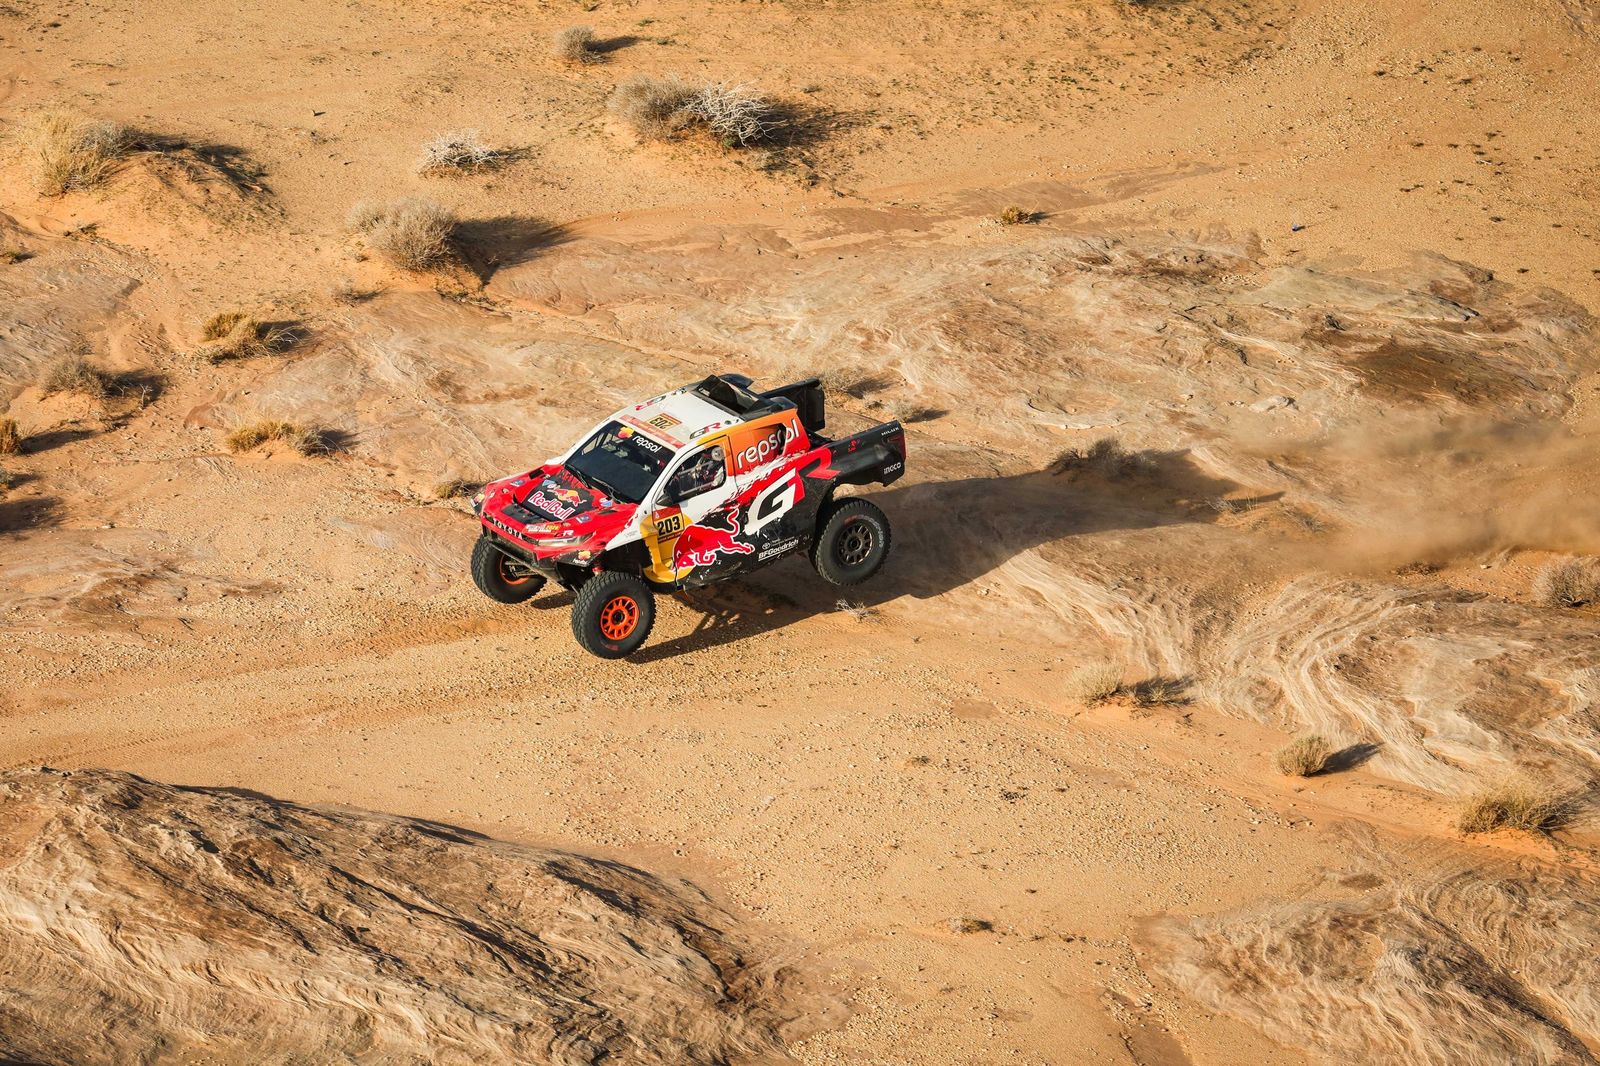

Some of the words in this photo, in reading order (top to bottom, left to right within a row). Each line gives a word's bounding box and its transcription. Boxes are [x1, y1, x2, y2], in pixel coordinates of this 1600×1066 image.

[649, 417, 674, 430] 203
[689, 422, 721, 439] GR
[632, 435, 662, 453] repsol
[737, 418, 799, 469] repsol
[744, 446, 841, 535] GR
[493, 518, 523, 540] TOYOTA
[656, 515, 681, 536] 203
[758, 539, 799, 559] BFGoodrich
